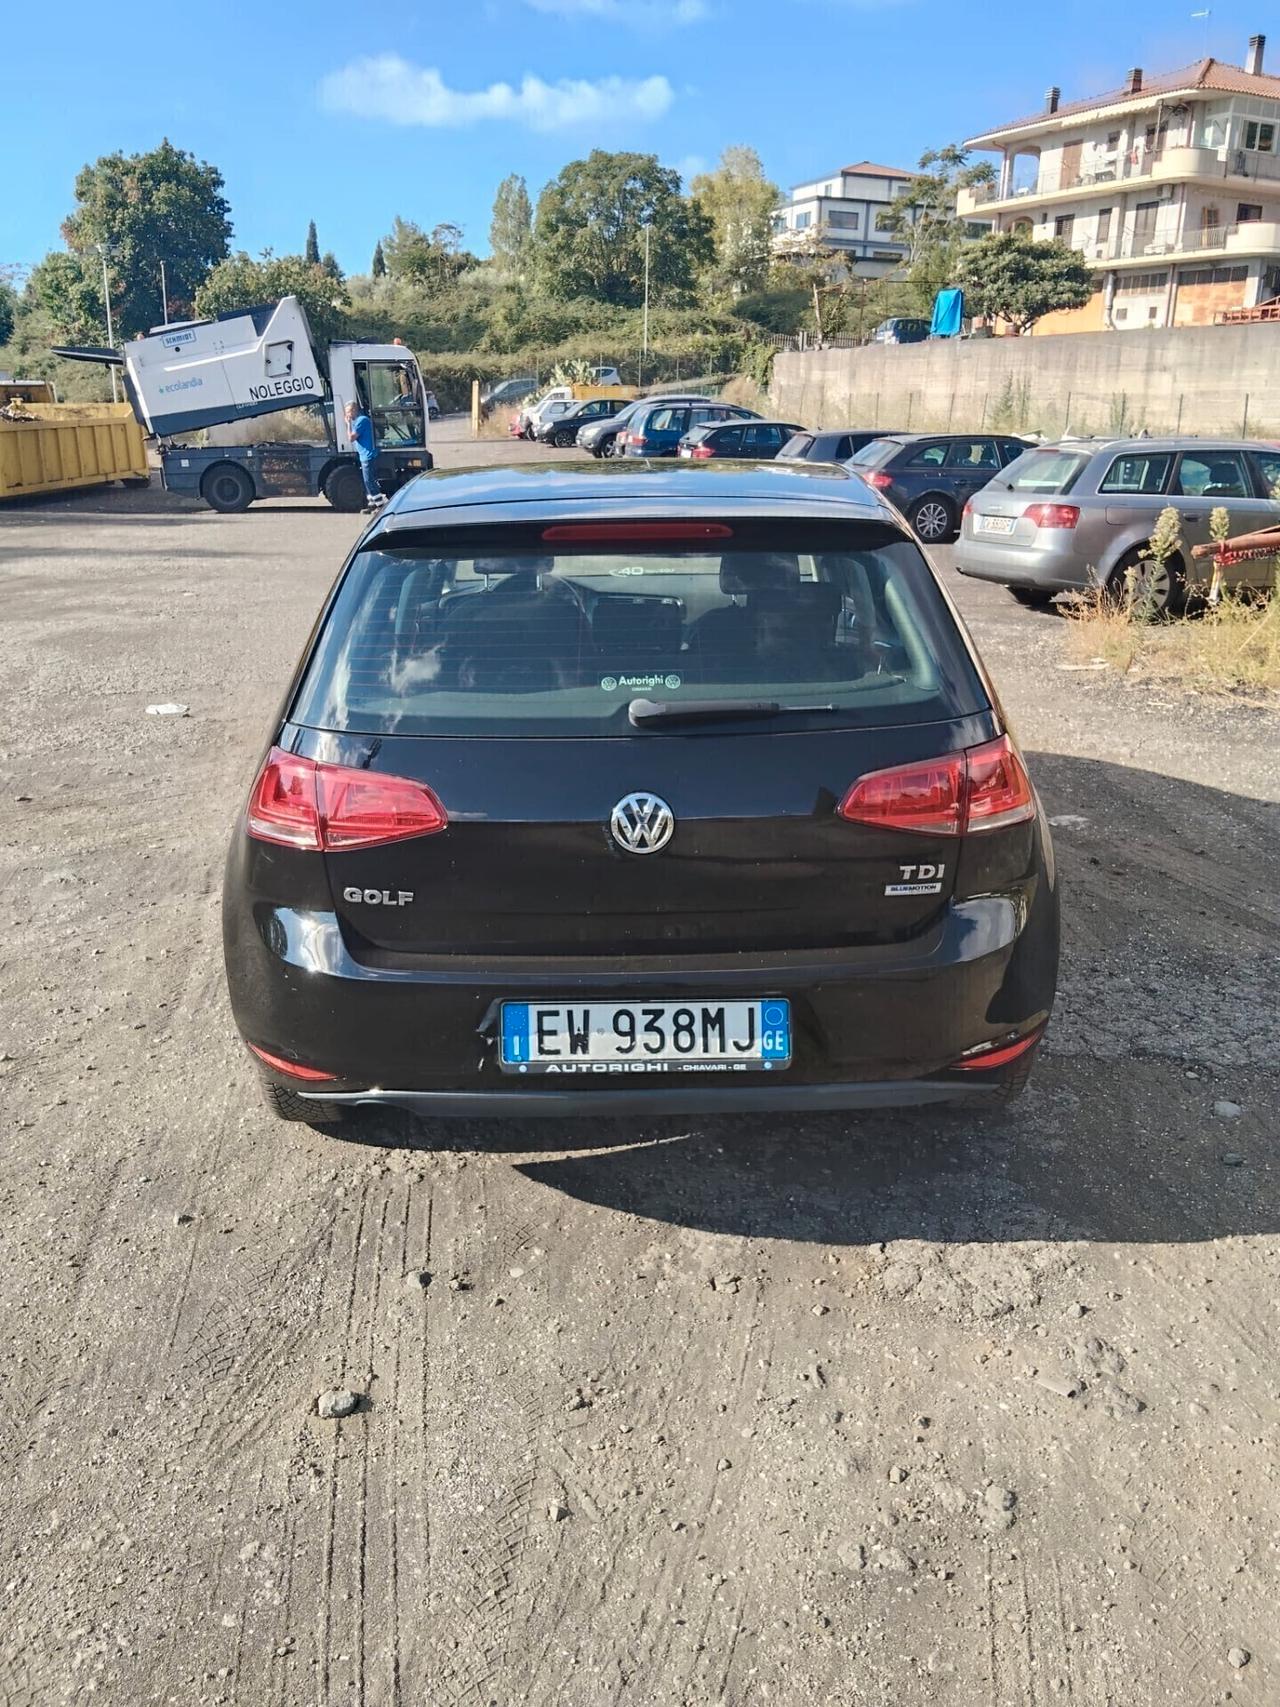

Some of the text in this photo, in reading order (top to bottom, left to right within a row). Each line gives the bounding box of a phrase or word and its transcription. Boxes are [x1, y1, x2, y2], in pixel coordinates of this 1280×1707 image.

[165, 332, 193, 345] SCHMIDT
[165, 376, 203, 393] ecolandia
[249, 375, 314, 400] NOLEGGIO
[619, 675, 664, 687] Autorighi
[899, 863, 945, 880] TDI
[343, 886, 414, 906] GOLF
[537, 1007, 755, 1055] EW 938MJ
[763, 1030, 784, 1051] GE
[545, 1063, 669, 1073] AUTORIGHI
